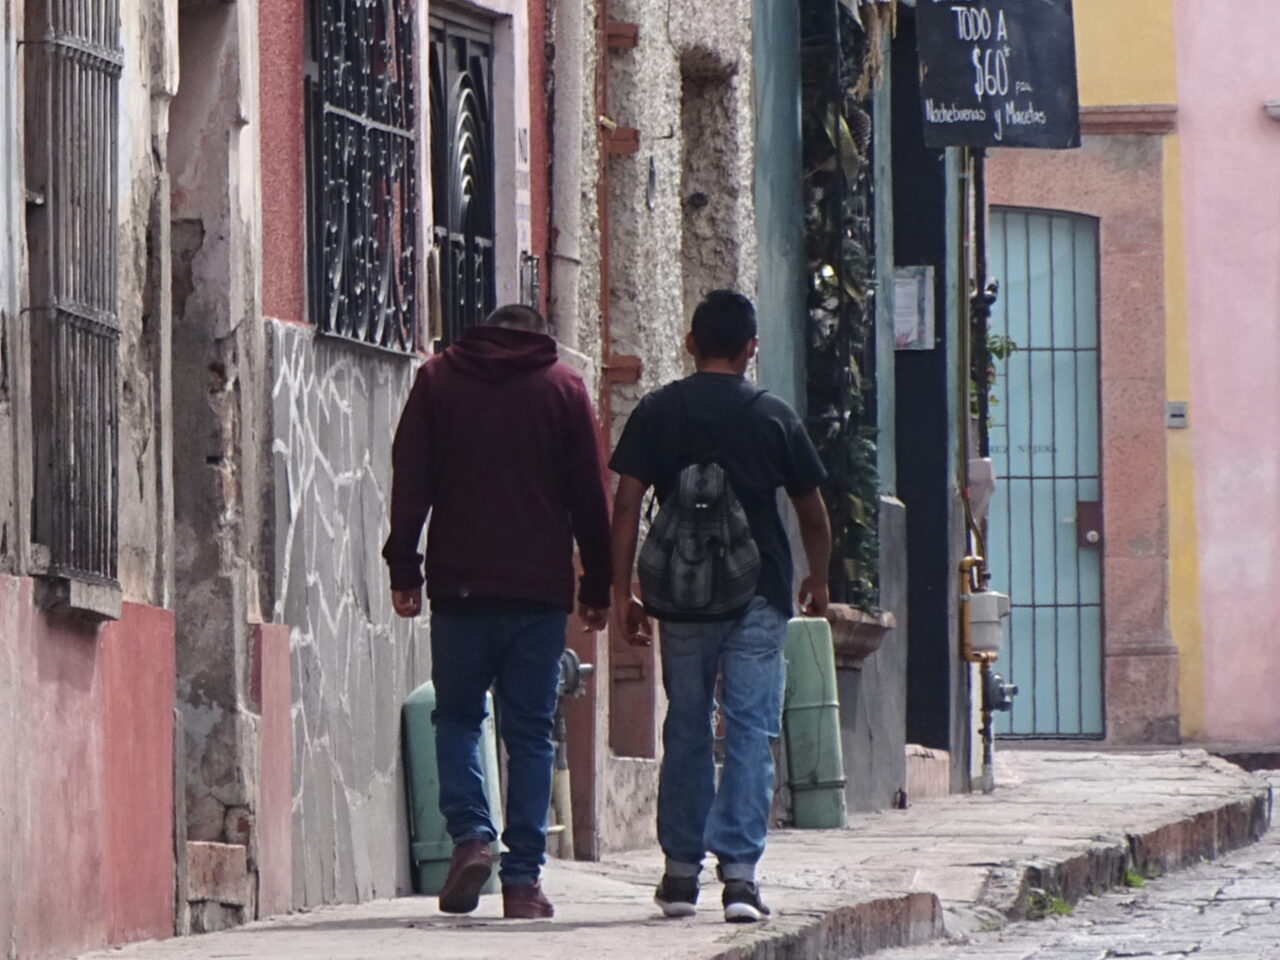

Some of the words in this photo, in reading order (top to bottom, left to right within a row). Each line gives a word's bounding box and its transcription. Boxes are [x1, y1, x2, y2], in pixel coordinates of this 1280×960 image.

[951, 6, 991, 41] TODO
[997, 9, 1008, 41] A
[994, 108, 1003, 141] y
[1005, 100, 1047, 125] Macetas
